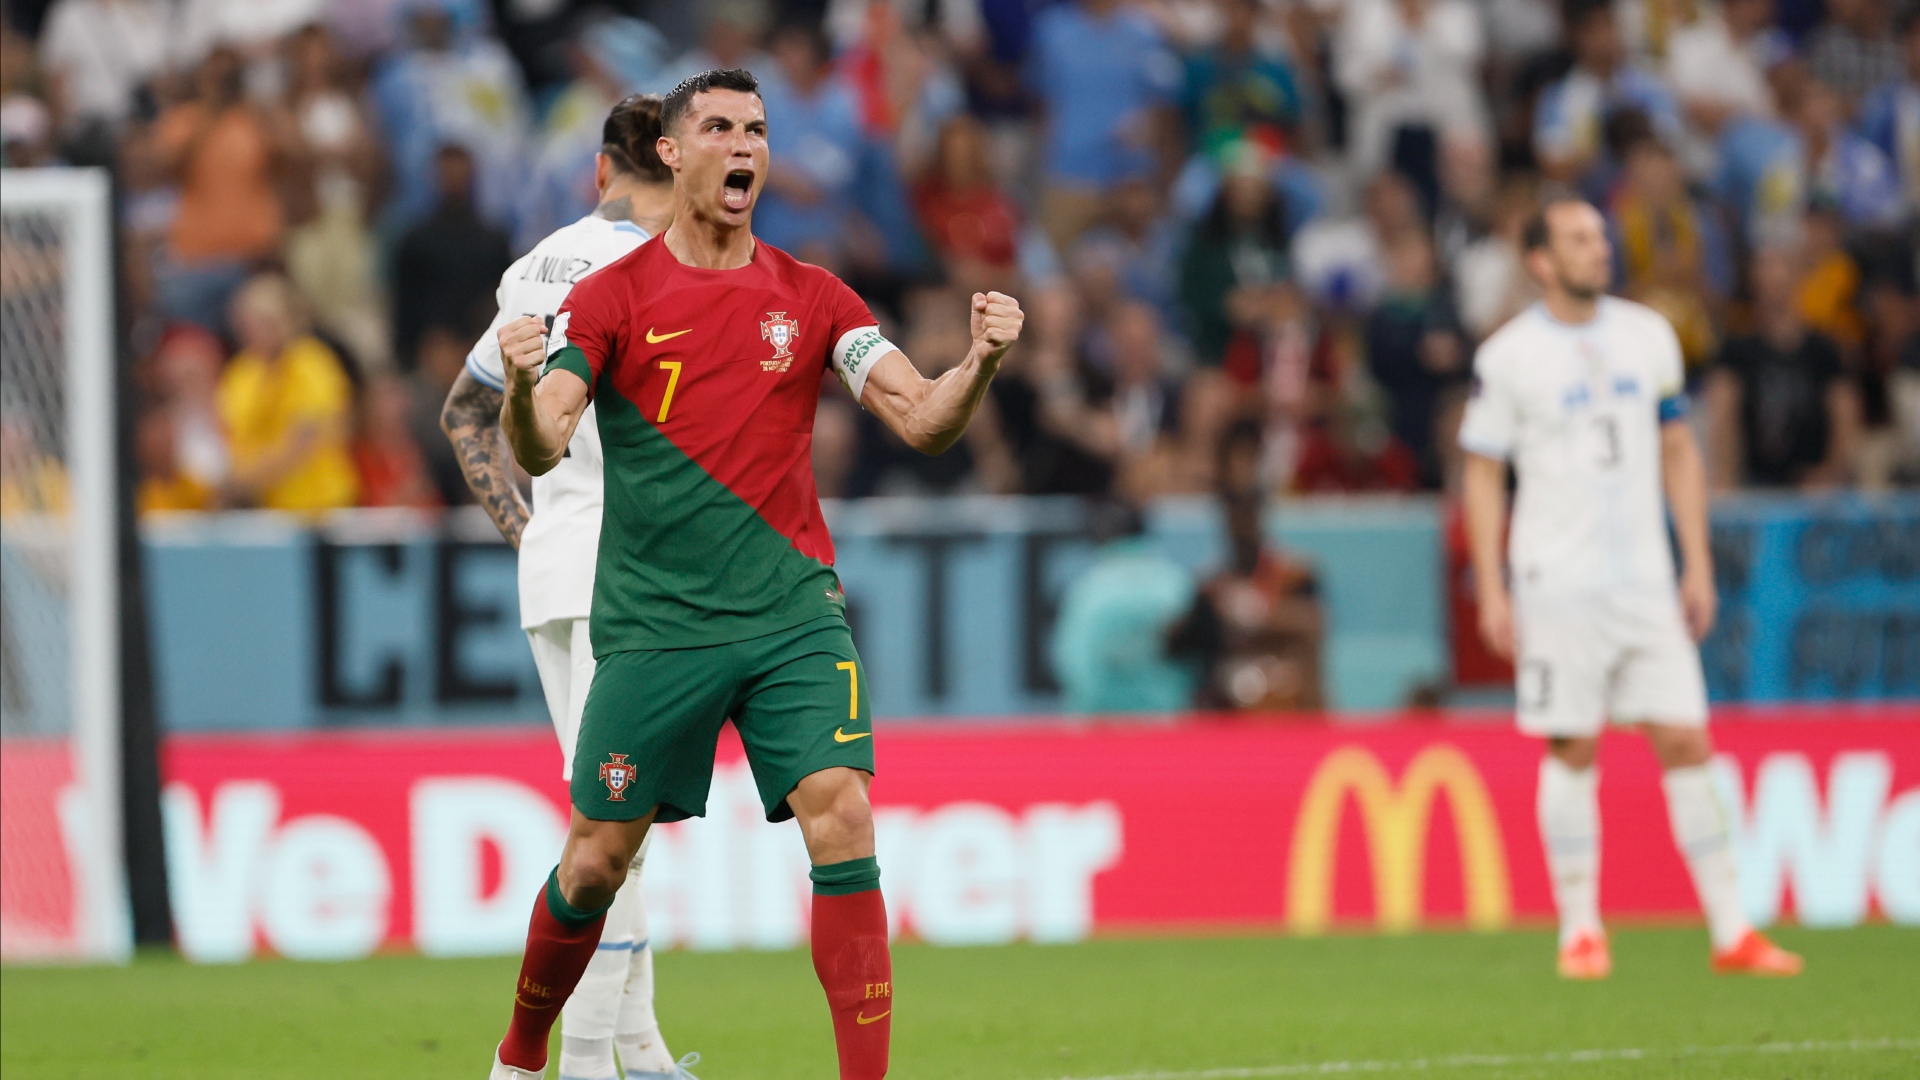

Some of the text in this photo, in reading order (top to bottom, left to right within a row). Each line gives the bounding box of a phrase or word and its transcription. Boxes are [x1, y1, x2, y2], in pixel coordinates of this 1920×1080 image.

[843, 337, 864, 367] SAVE
[657, 361, 681, 423] 7
[1590, 413, 1626, 472] 3
[836, 661, 858, 720] 7
[58, 780, 392, 965] We
